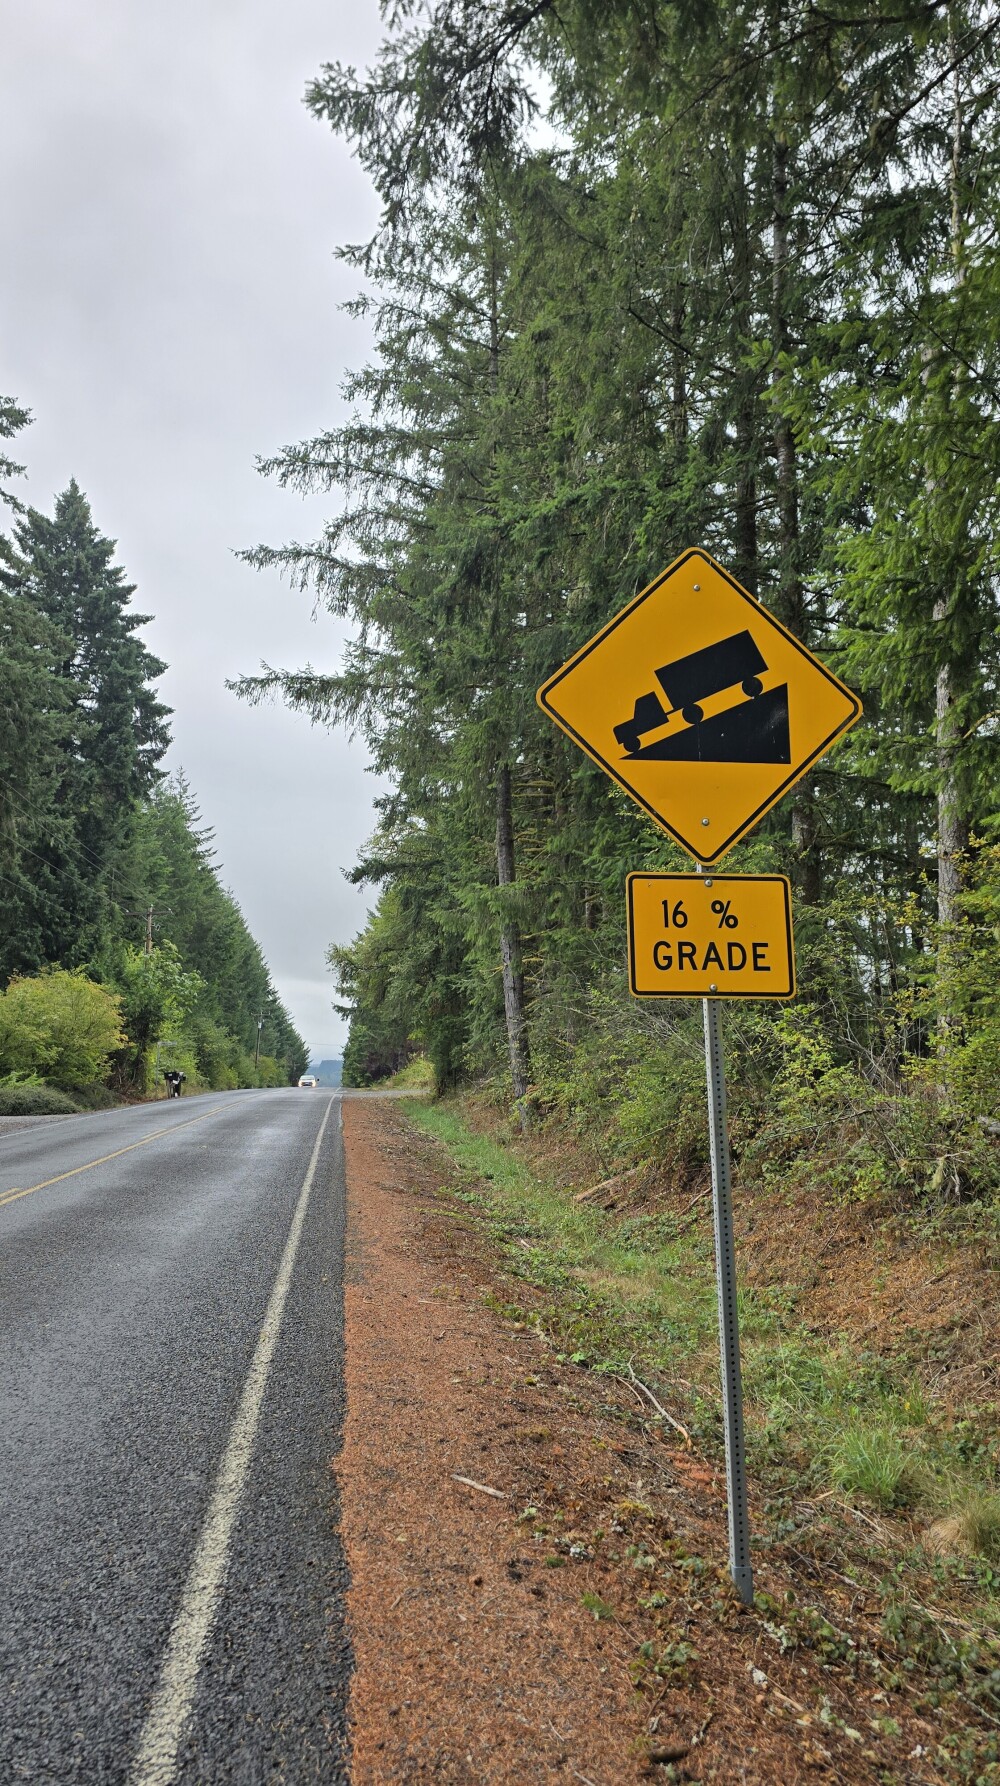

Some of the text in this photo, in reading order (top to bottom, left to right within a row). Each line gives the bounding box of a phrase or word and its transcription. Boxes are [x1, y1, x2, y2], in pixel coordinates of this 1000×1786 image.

[662, 899, 739, 929] 16 %
[653, 941, 771, 971] GRADE
